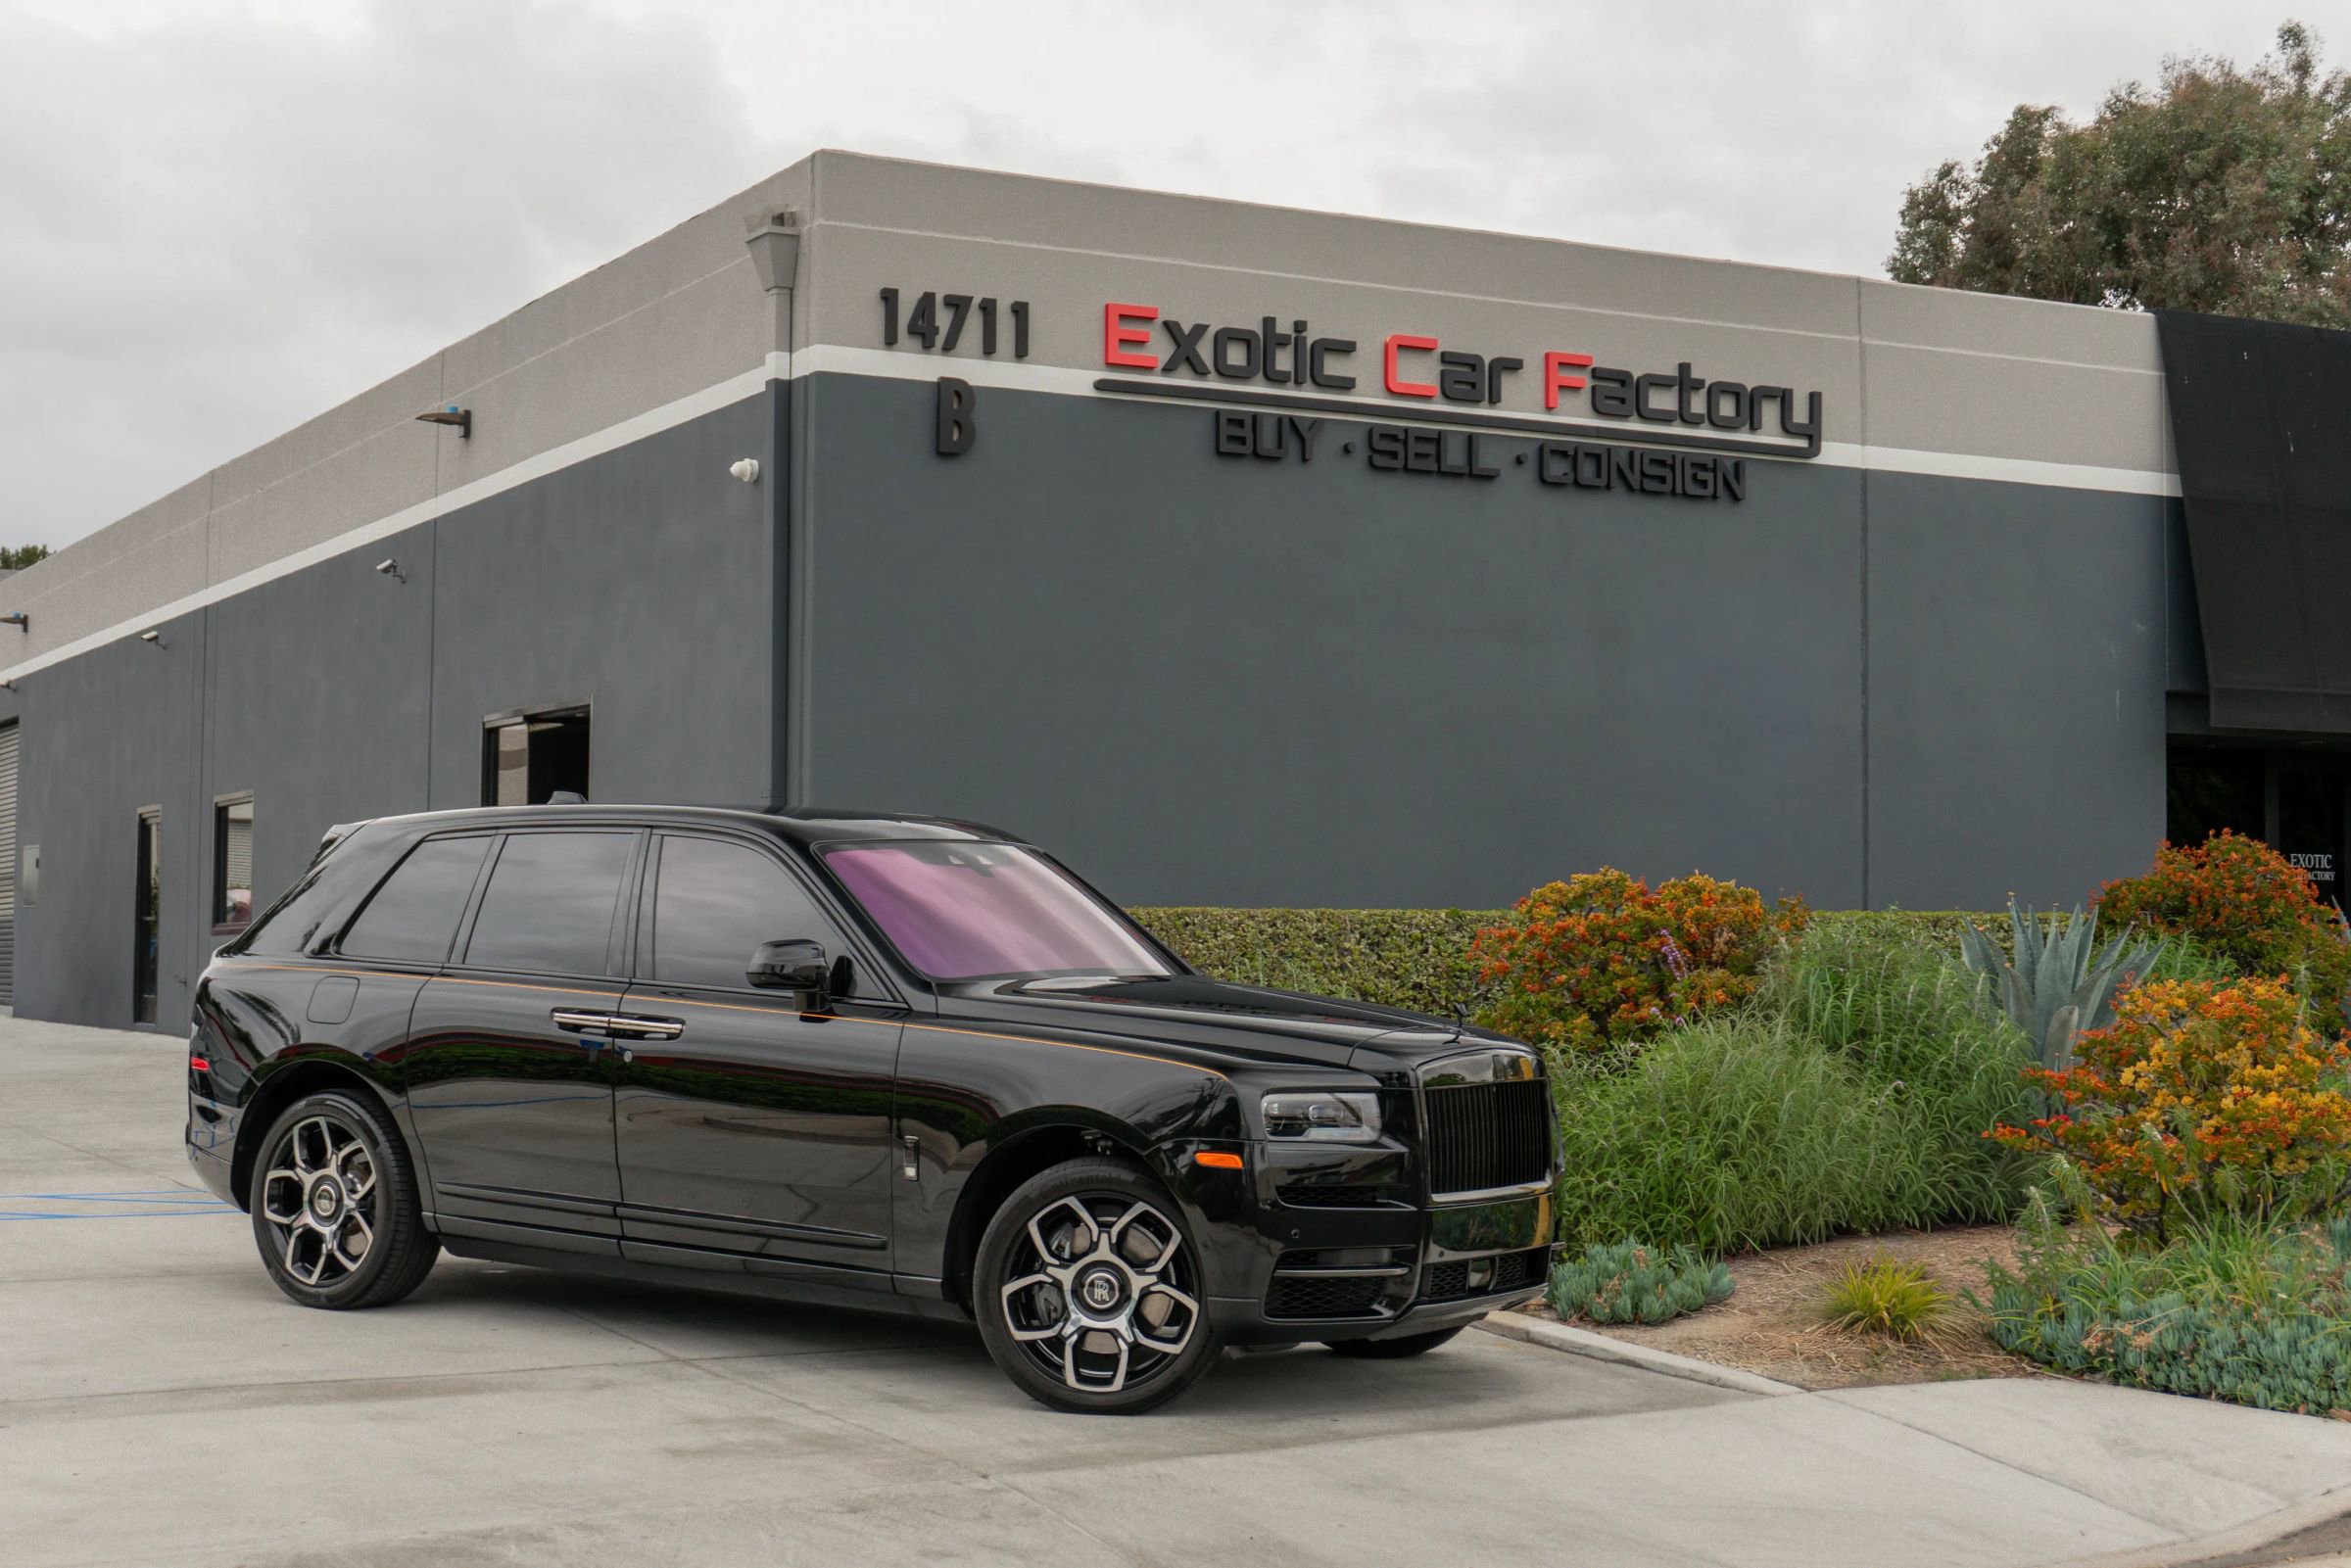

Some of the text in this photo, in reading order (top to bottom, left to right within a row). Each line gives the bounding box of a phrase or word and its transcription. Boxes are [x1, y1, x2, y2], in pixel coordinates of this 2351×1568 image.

[880, 287, 1030, 357] 14711
[936, 376, 977, 455] B
[1105, 303, 1822, 458] Exotic Car Factory
[1215, 409, 1747, 501] BUY SELL CONSIGN
[2289, 853, 2332, 869] EXOTIC
[2305, 871, 2335, 881] ACTORY
